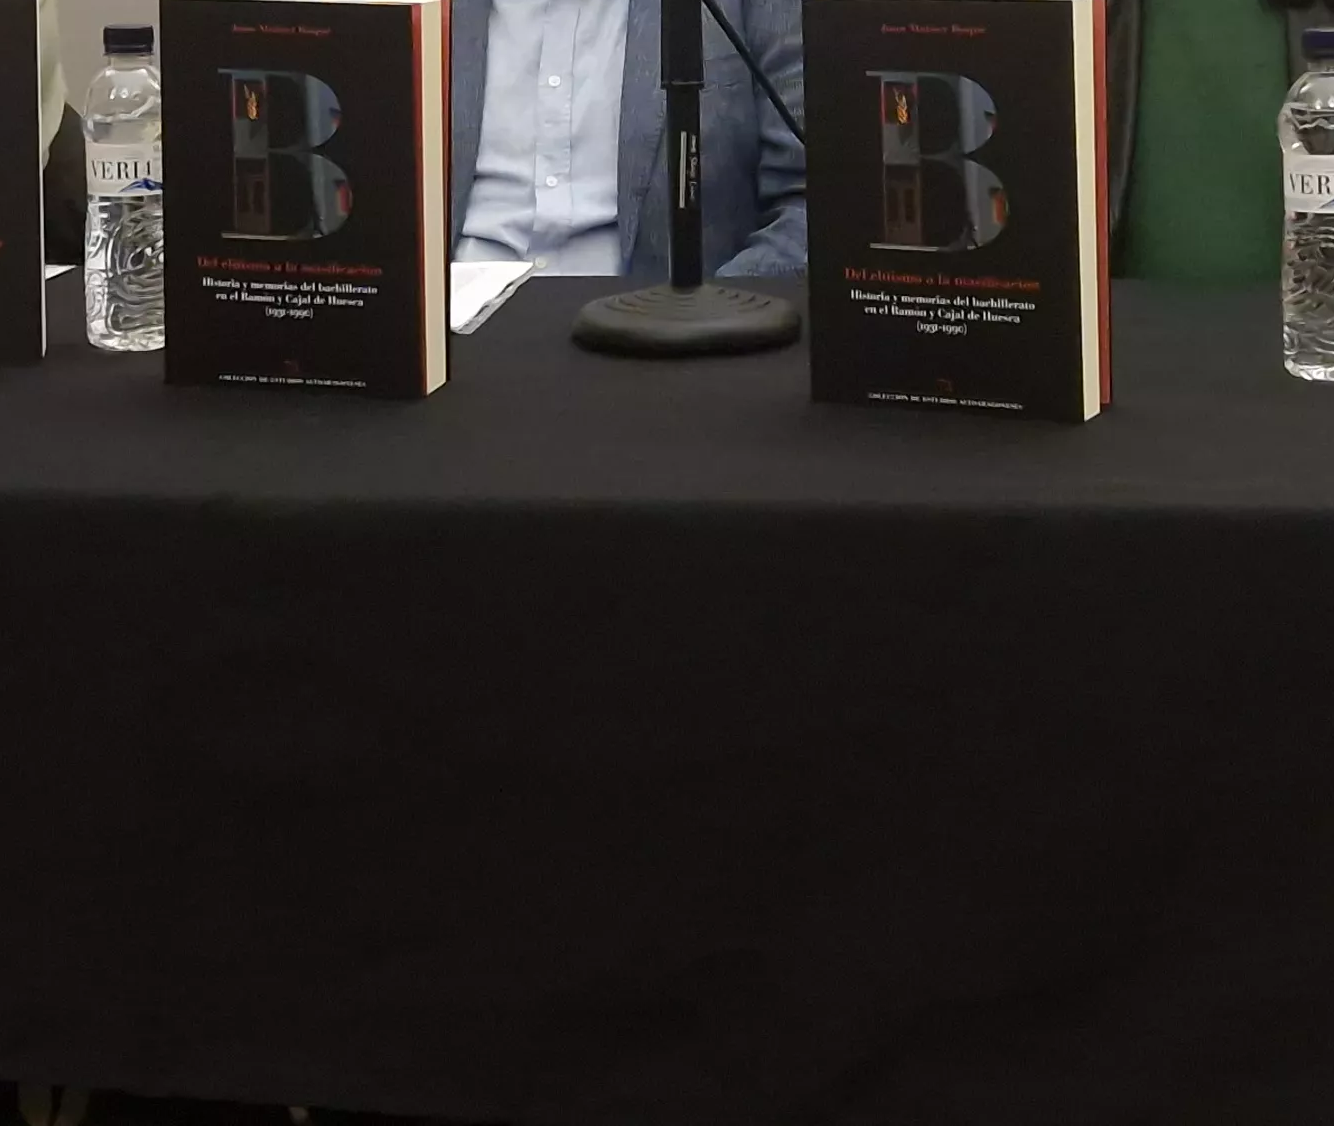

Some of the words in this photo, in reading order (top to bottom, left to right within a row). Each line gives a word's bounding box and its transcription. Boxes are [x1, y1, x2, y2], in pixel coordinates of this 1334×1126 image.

[217, 68, 354, 242] B
[865, 70, 1010, 253] B
[203, 277, 240, 288] Historia
[242, 282, 248, 291] y
[250, 281, 299, 291] memorias
[300, 282, 316, 292] del
[318, 283, 378, 294] bachillerato
[215, 293, 227, 301] en
[229, 291, 238, 301] el
[277, 295, 282, 305] y
[285, 294, 311, 306] Cajal
[313, 295, 326, 305] de
[328, 295, 364, 307] Huesca
[851, 289, 890, 301] Historia
[892, 295, 898, 305] y
[901, 295, 951, 305] memorias
[953, 296, 970, 307] del
[972, 296, 1036, 311] bachillerato
[864, 306, 877, 314] en
[879, 305, 889, 315] el
[929, 310, 935, 320] y
[937, 308, 965, 322] Cajal
[967, 310, 981, 321] de
[982, 310, 1021, 324] Huesca
[916, 320, 968, 336] (1931-1990)
